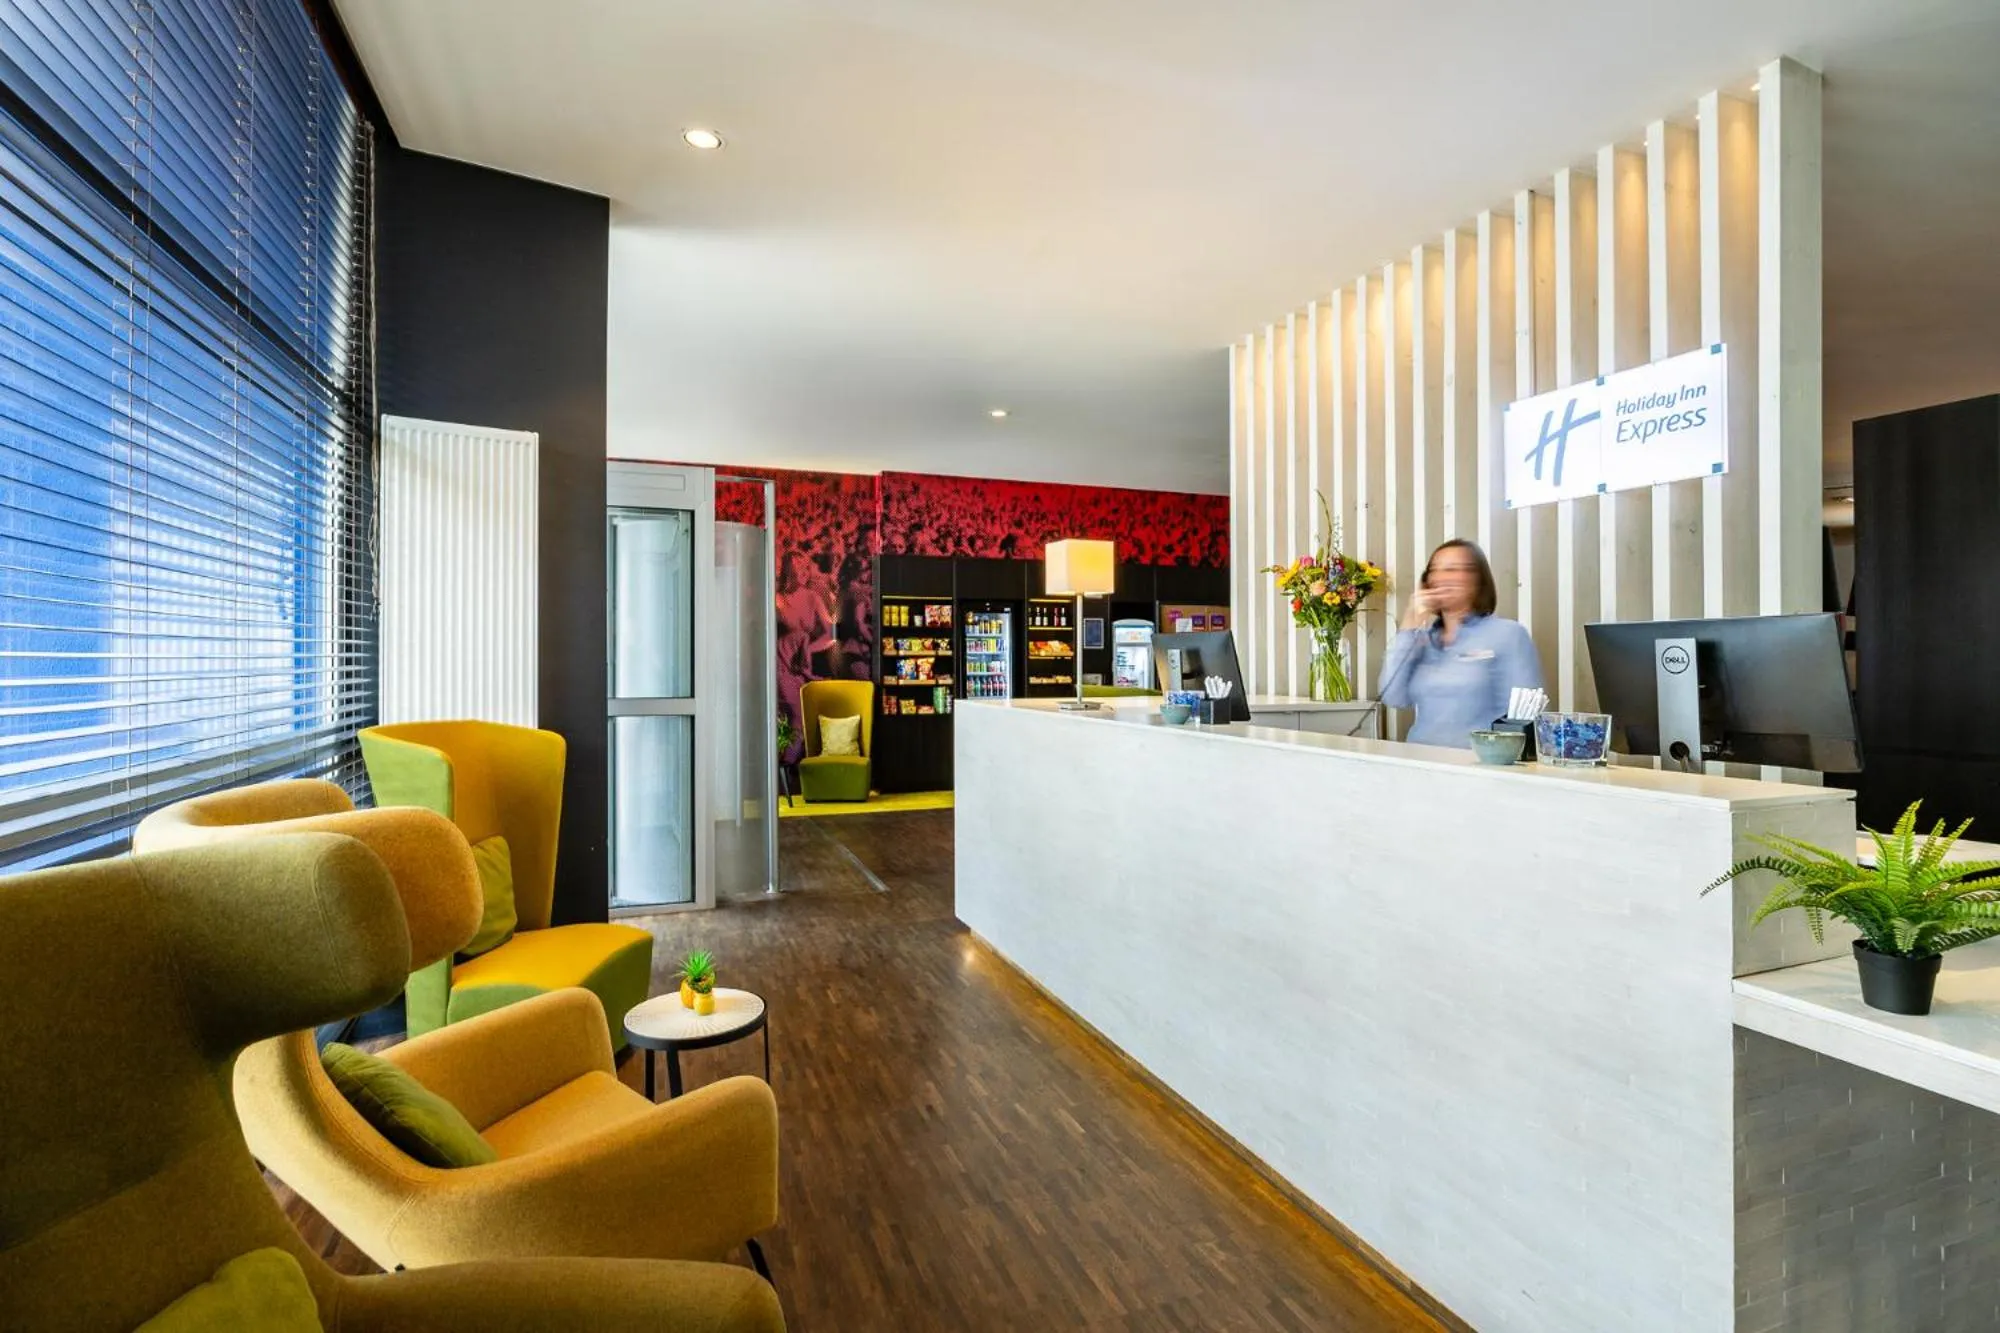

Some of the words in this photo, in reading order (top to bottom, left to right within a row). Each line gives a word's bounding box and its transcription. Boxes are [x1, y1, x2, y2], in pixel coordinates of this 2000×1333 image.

[1616, 392, 1676, 416] Holiday
[1681, 385, 1706, 401] Inn
[1616, 408, 1707, 443] Express
[1664, 656, 1686, 664] DELL
